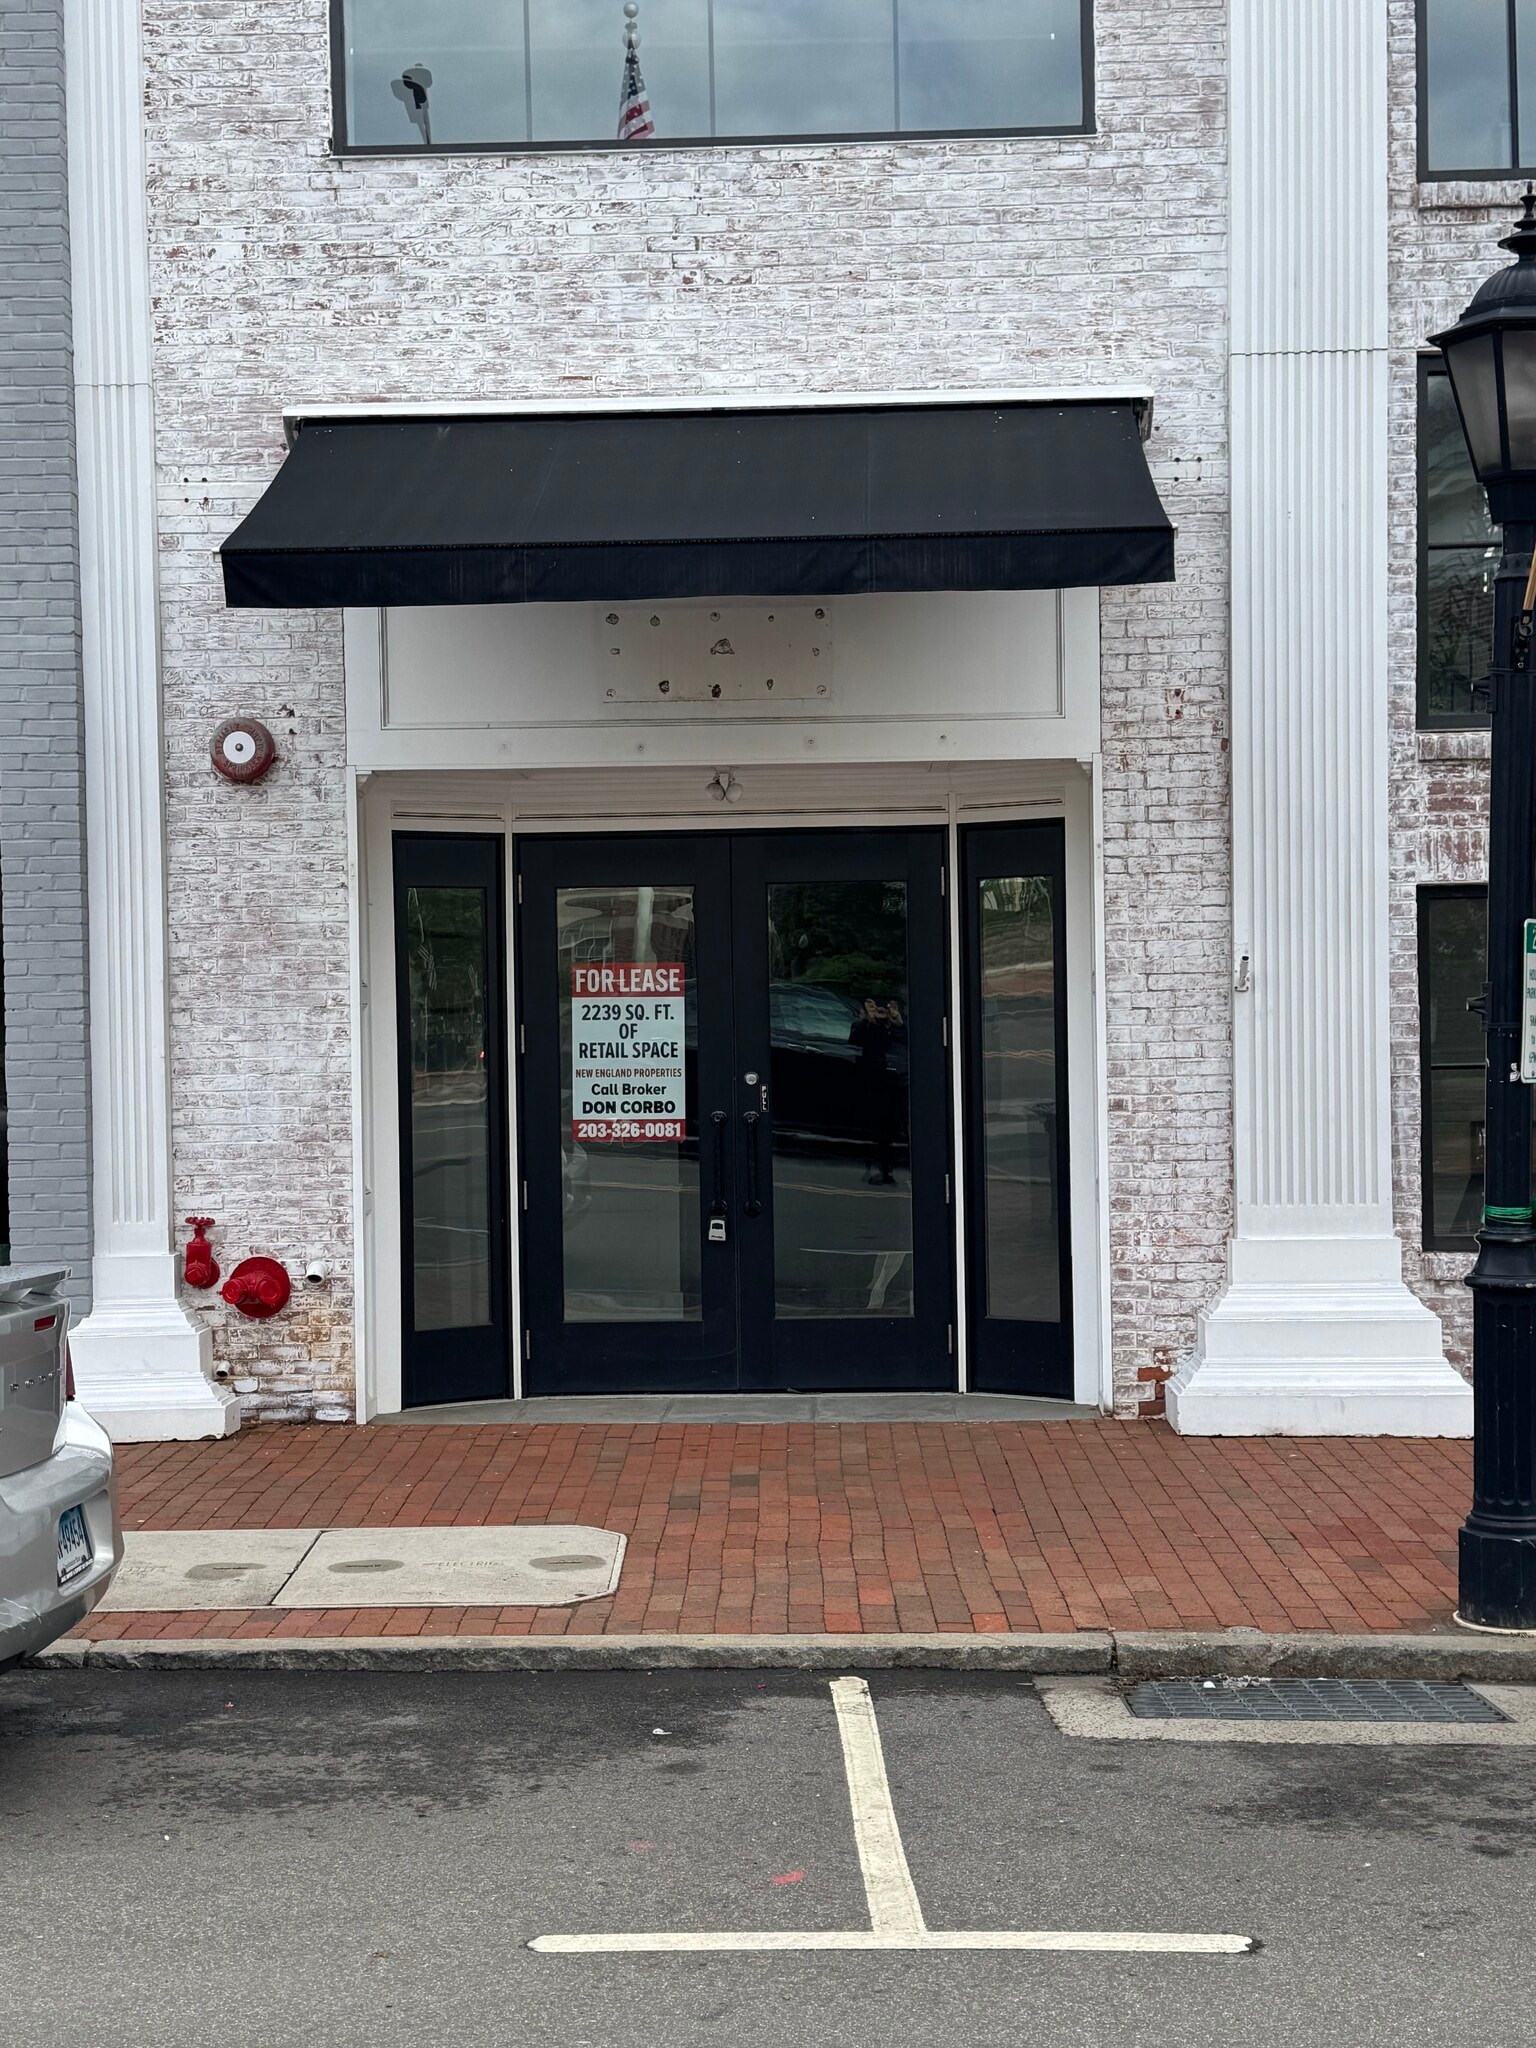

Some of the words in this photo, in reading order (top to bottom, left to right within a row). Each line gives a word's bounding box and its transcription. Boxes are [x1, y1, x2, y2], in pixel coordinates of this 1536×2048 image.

[575, 968, 614, 992] FOR
[620, 968, 680, 992] LEASE
[581, 1004, 621, 1021] 2239
[625, 1004, 650, 1022] SQ.
[654, 1004, 675, 1021] FT.
[619, 1023, 638, 1040] OF
[579, 1042, 629, 1059] RETAIL
[632, 1042, 679, 1059] SPACE
[575, 1069, 593, 1078] NEW
[595, 1068, 632, 1078] ENGLAND
[633, 1068, 682, 1078] PROPERTIES
[591, 1083, 619, 1096] Call
[622, 1083, 667, 1096] Broker
[582, 1101, 617, 1114] DON
[620, 1101, 676, 1114] CORBO
[577, 1122, 681, 1138] 203-326-0081
